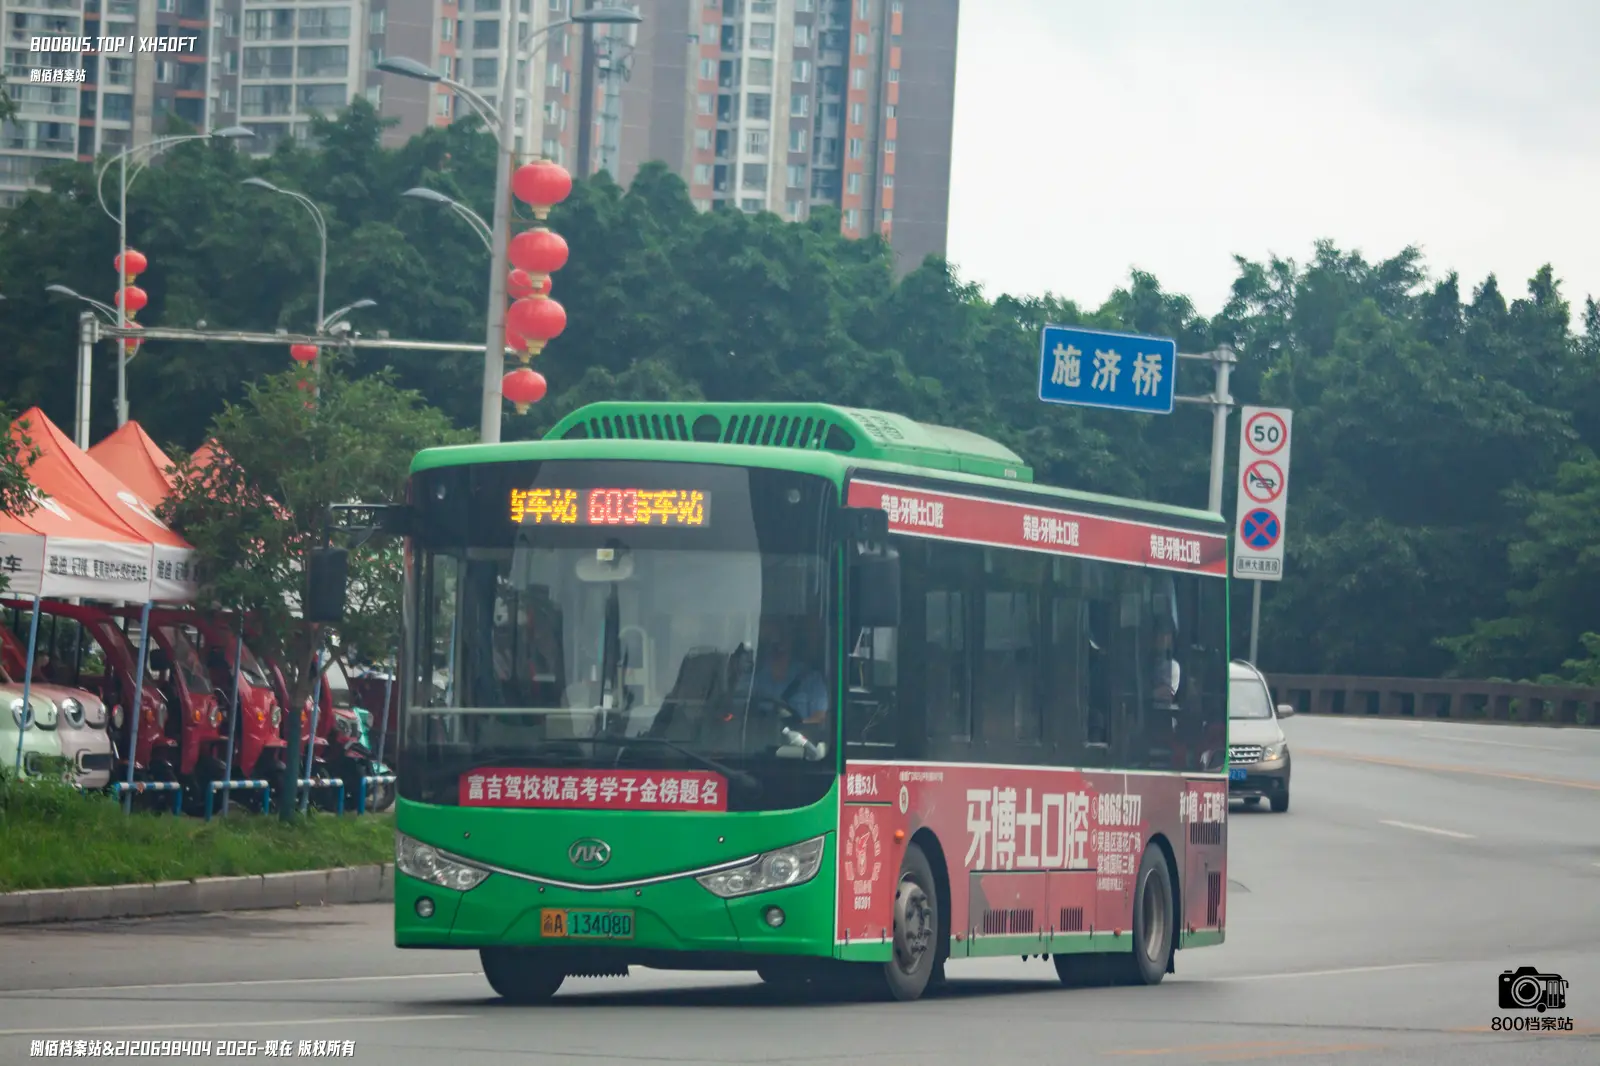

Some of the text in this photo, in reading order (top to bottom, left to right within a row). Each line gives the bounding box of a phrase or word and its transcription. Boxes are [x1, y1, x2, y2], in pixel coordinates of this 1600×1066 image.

[1051, 342, 1163, 397] 施济桥
[1254, 426, 1279, 443] 50
[0, 554, 22, 573] 车
[468, 775, 719, 805] 富吉驾校祝高考学子金榜题名
[964, 786, 1090, 870] 牙博士口腔
